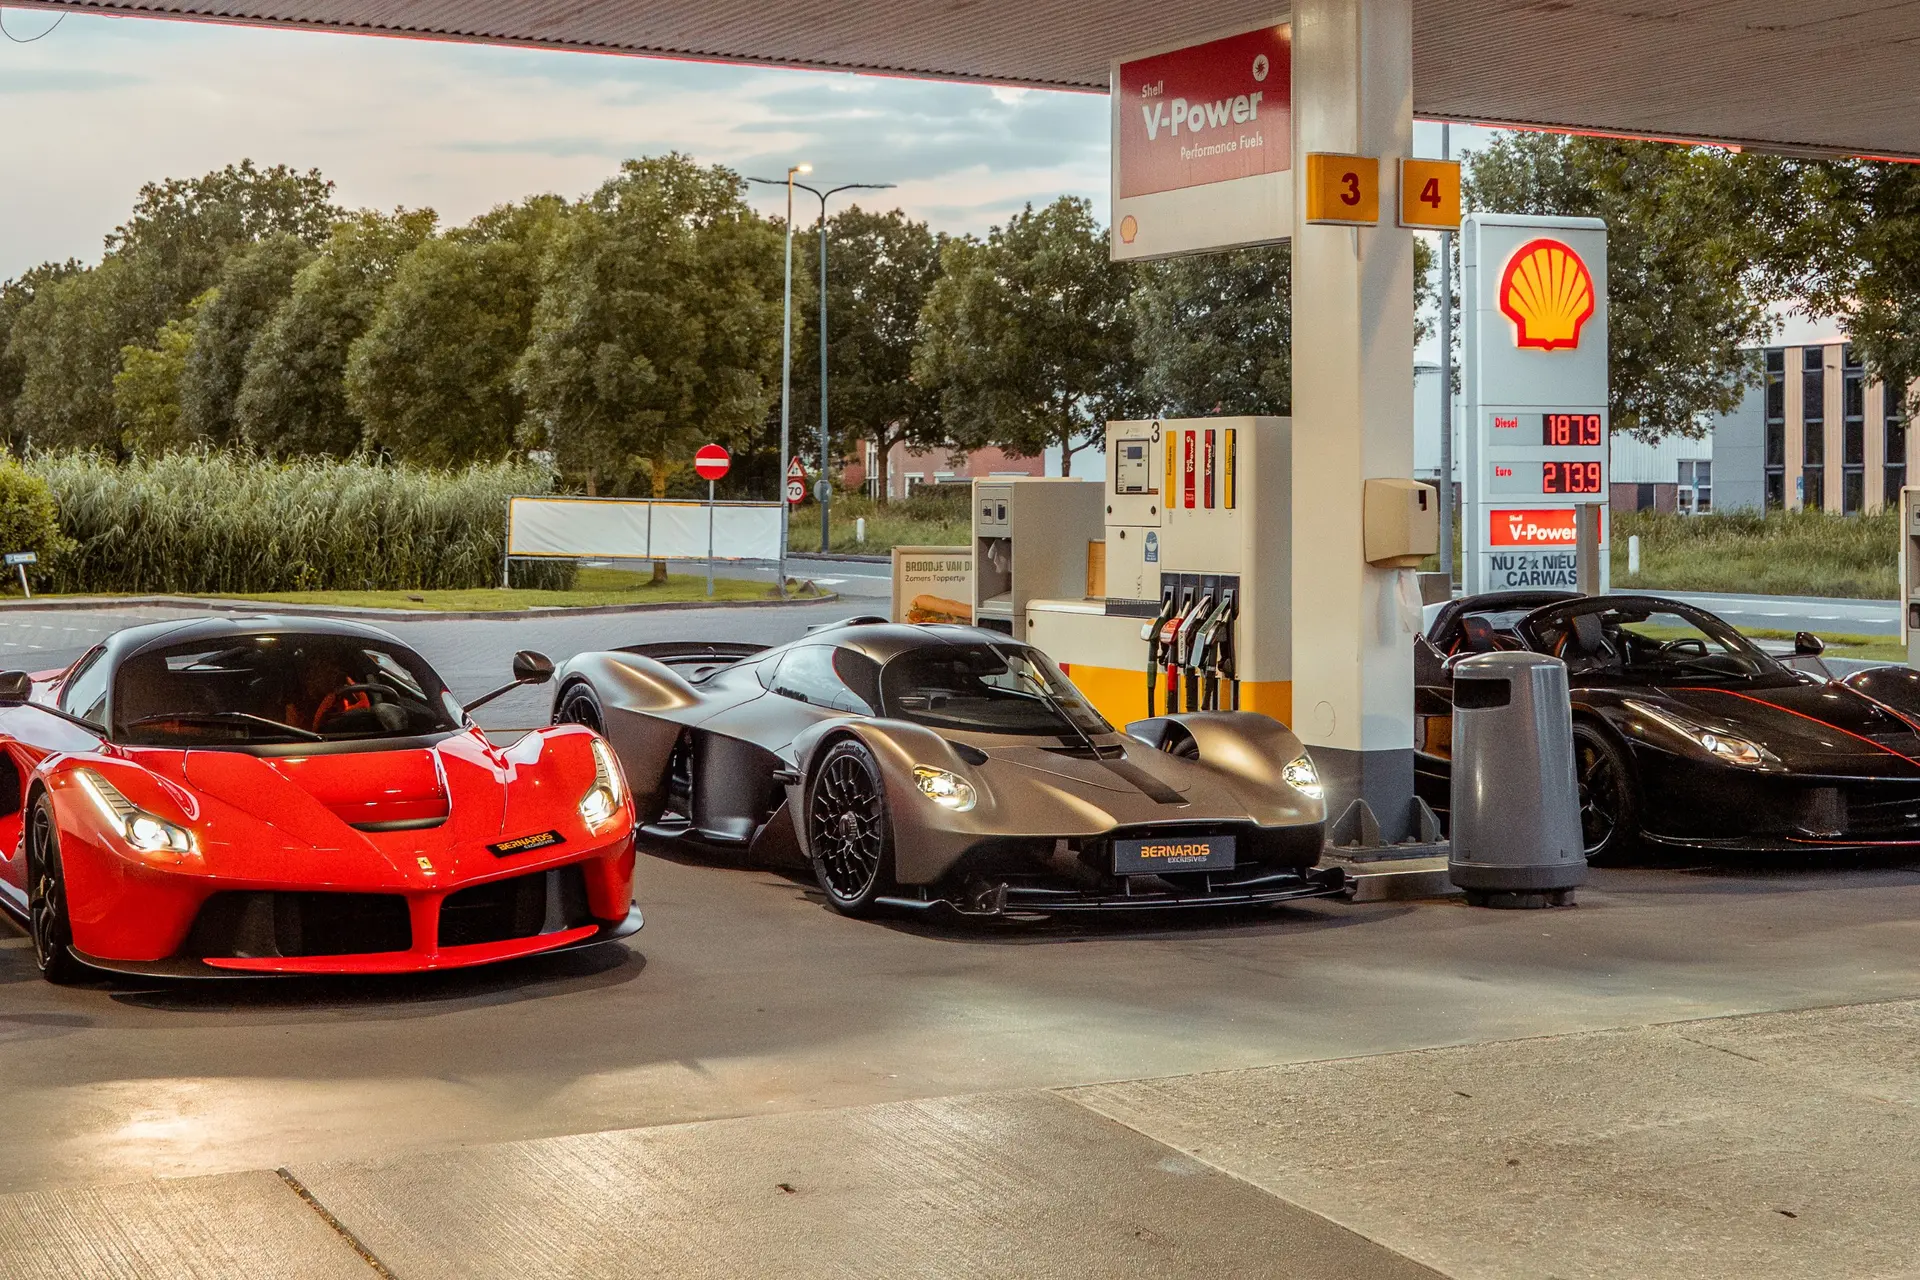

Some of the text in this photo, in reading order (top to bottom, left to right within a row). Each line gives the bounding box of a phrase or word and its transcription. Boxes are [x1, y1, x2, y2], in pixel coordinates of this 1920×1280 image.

[1142, 80, 1163, 98] Shell
[1142, 91, 1263, 141] V-Power
[1180, 131, 1263, 160] Performance Fuels
[1340, 172, 1361, 206] 3
[1420, 178, 1441, 209] 4
[1151, 421, 1160, 444] 3
[1495, 415, 1600, 445] Diesel 187.9
[1495, 466, 1512, 477] Euro
[788, 486, 802, 496] 70
[905, 561, 944, 572] BROODJE
[946, 561, 962, 571] VAN
[1491, 556, 1514, 570] NU
[1518, 556, 1527, 569] 2
[1543, 555, 1577, 570] NIEU
[1506, 570, 1577, 587] CARWAS
[496, 832, 553, 851] BERNARDS
[1141, 844, 1210, 857] BERNARDS
